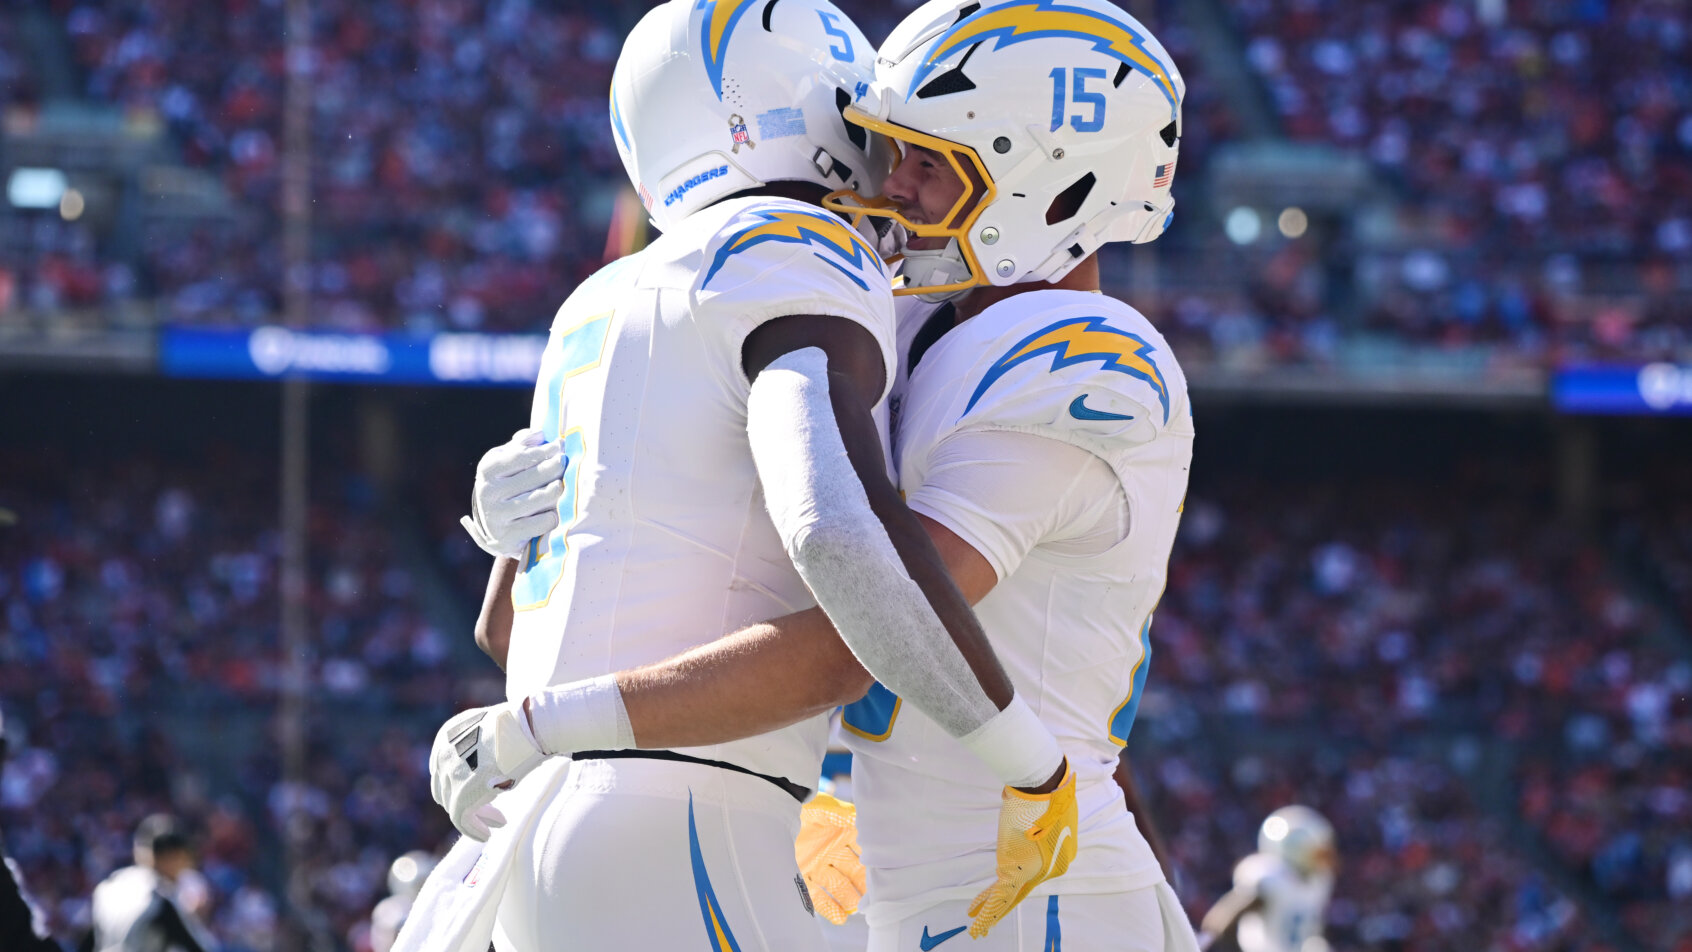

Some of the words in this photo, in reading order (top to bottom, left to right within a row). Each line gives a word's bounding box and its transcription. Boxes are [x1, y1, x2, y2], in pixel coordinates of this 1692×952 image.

[815, 8, 855, 63] 5
[1048, 67, 1107, 133] 15
[734, 131, 748, 142] NFL
[664, 165, 728, 206] CHARGERS
